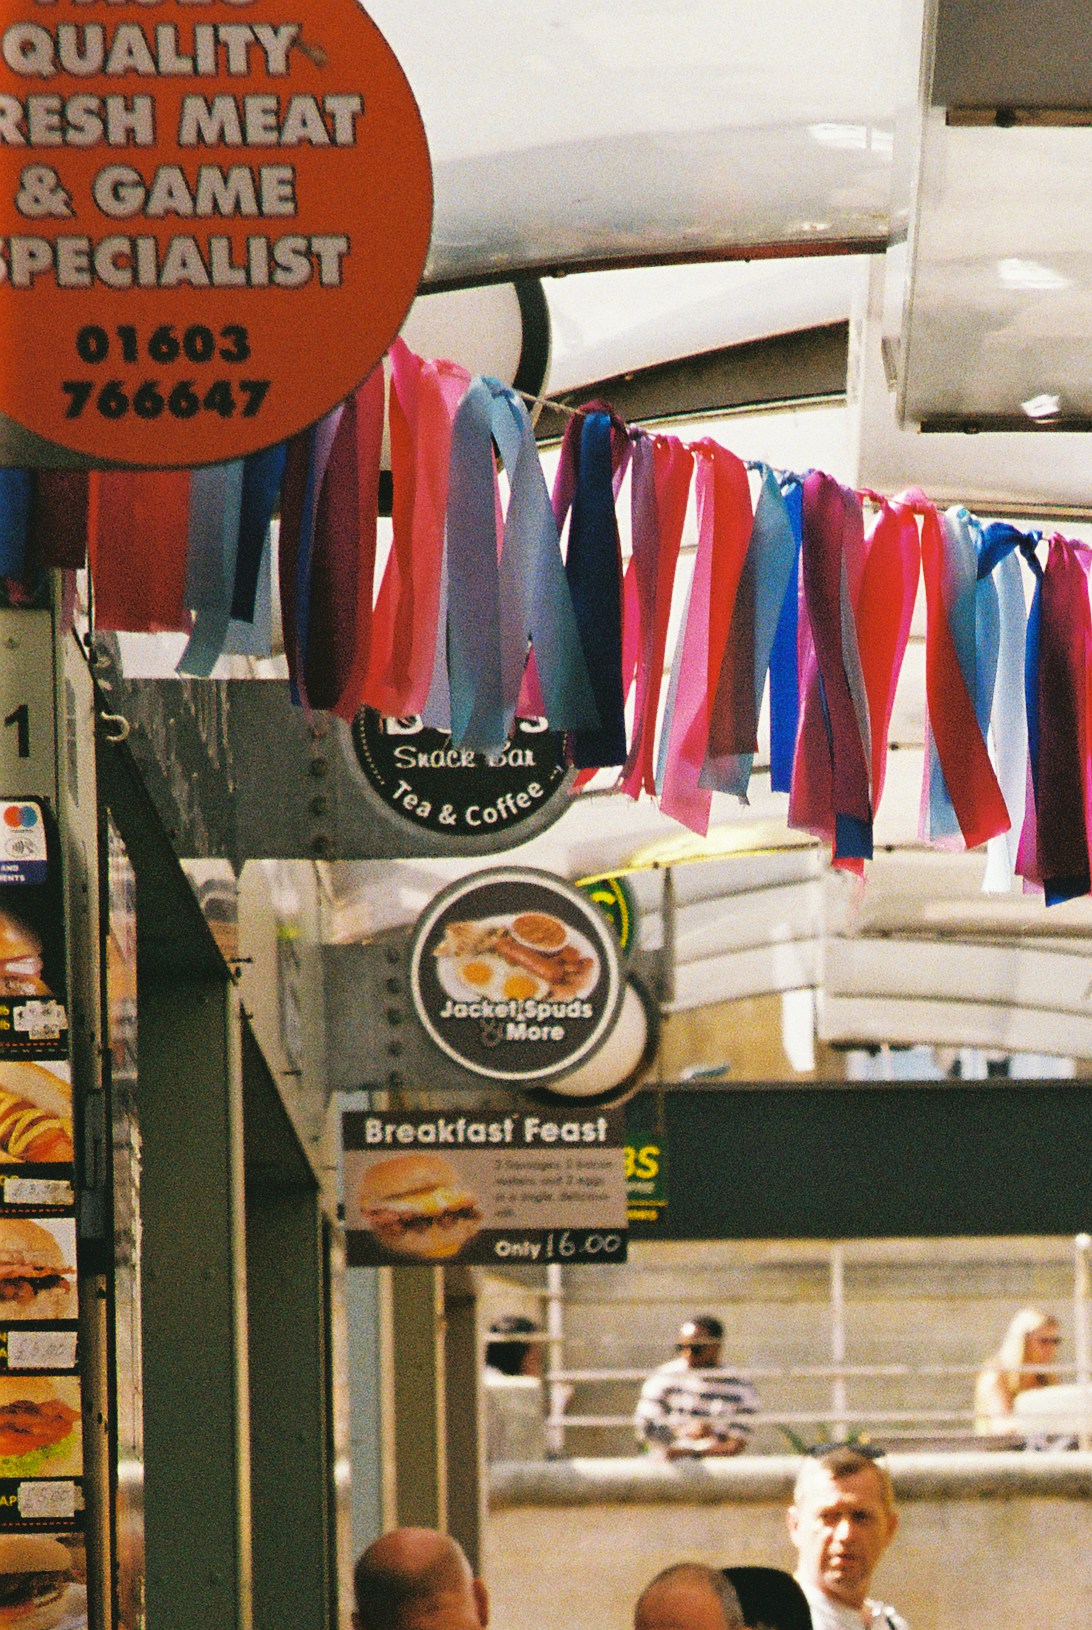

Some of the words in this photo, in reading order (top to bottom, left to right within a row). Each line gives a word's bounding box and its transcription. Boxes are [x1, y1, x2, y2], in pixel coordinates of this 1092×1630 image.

[1, 22, 302, 79] QUALITY
[178, 93, 364, 147] MEAT
[14, 163, 77, 219] &
[92, 163, 298, 219] GAME
[0, 233, 350, 290] PECIALIST
[76, 324, 250, 365] 01603
[61, 379, 271, 420] 766647
[4, 704, 30, 758] 1
[394, 745, 476, 769] Snack
[392, 780, 432, 818] Tea
[438, 804, 457, 826] &
[465, 781, 544, 826] Coffee
[440, 998, 516, 1019] Jacket
[524, 1000, 593, 1021] Spuds
[506, 1023, 565, 1041] More
[365, 1118, 513, 1144] Breakfast
[524, 1117, 607, 1143] Feast
[495, 1240, 541, 1259] Only
